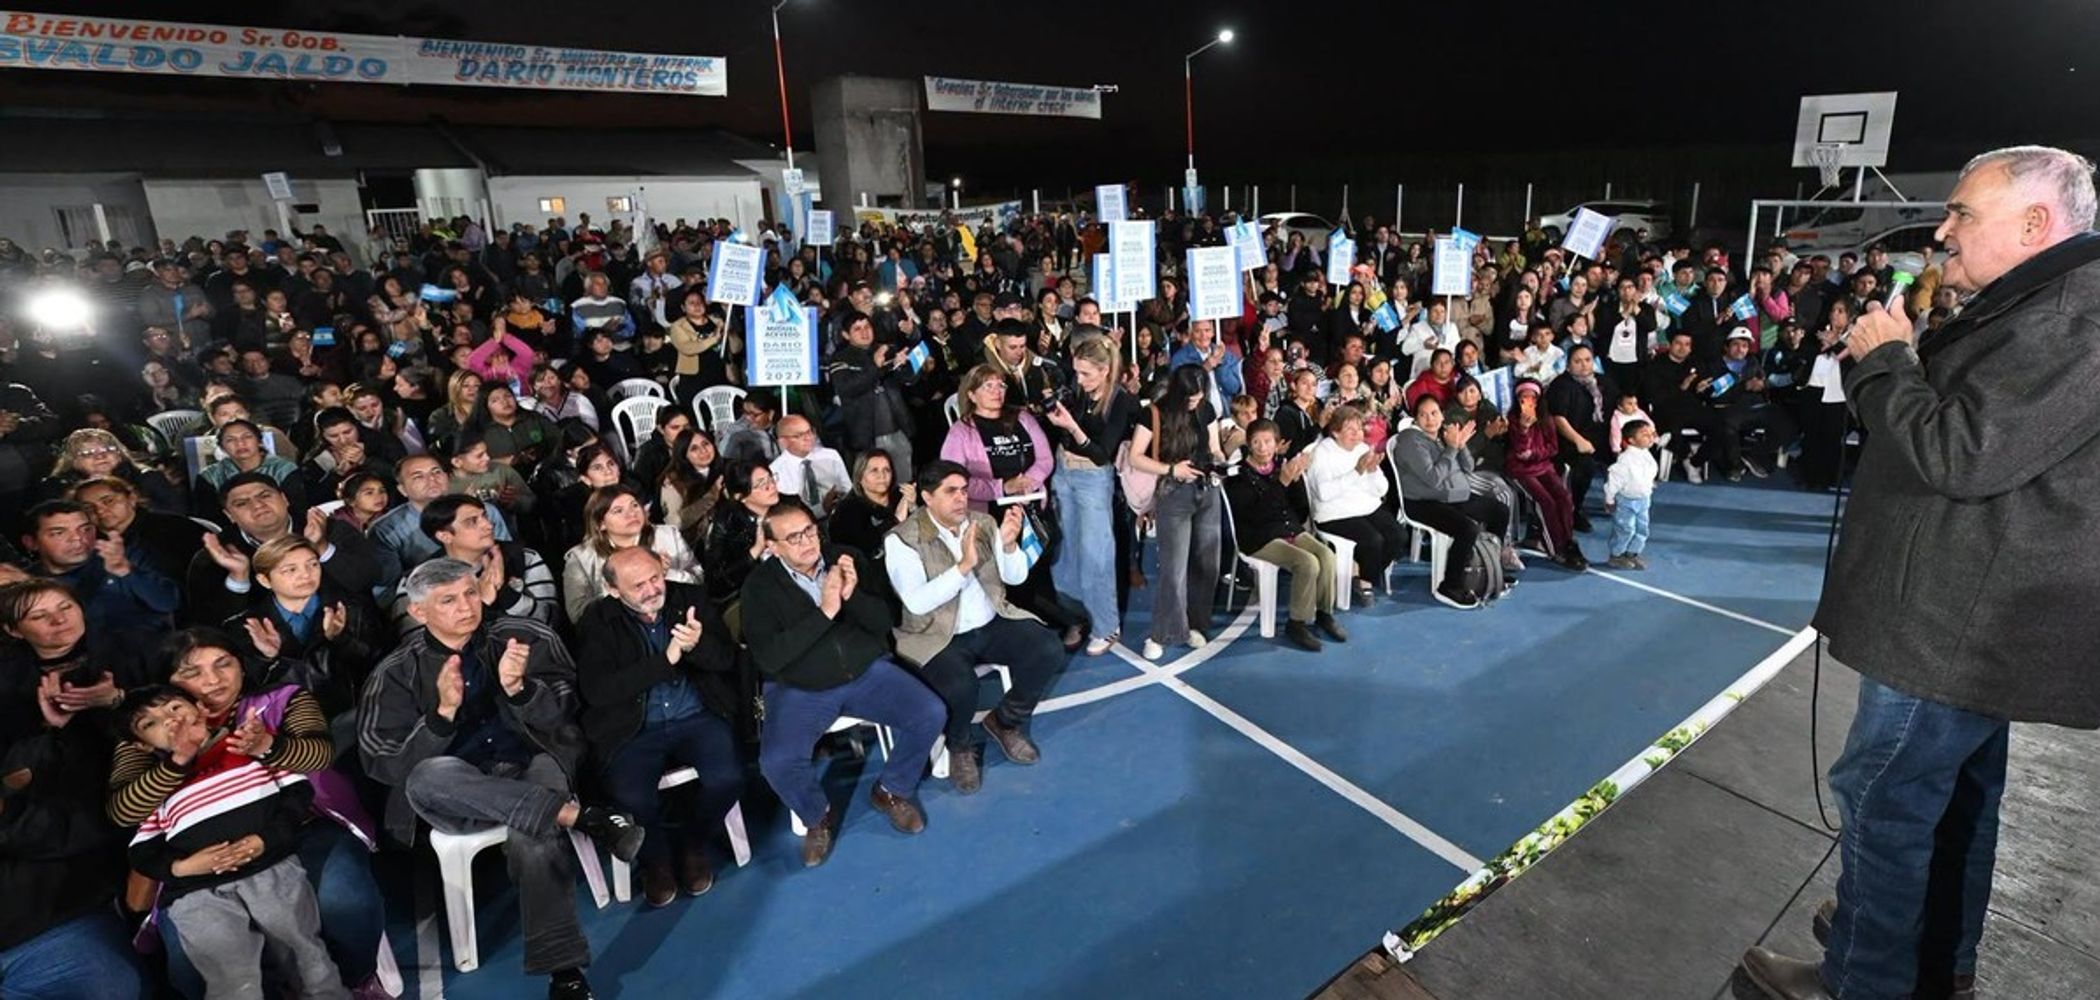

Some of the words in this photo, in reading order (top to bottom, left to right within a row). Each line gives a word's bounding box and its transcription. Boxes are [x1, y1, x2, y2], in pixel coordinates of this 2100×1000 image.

[5, 14, 228, 44] BIENVENIDO
[240, 28, 275, 47] Sr.
[282, 31, 346, 52] GOB.
[417, 40, 527, 61] BIENVENIDO
[219, 50, 388, 79] JALDO
[455, 58, 556, 86] DARIO
[720, 291, 747, 301] 2027
[1204, 306, 1231, 315] 2027
[765, 372, 802, 381] 2027
